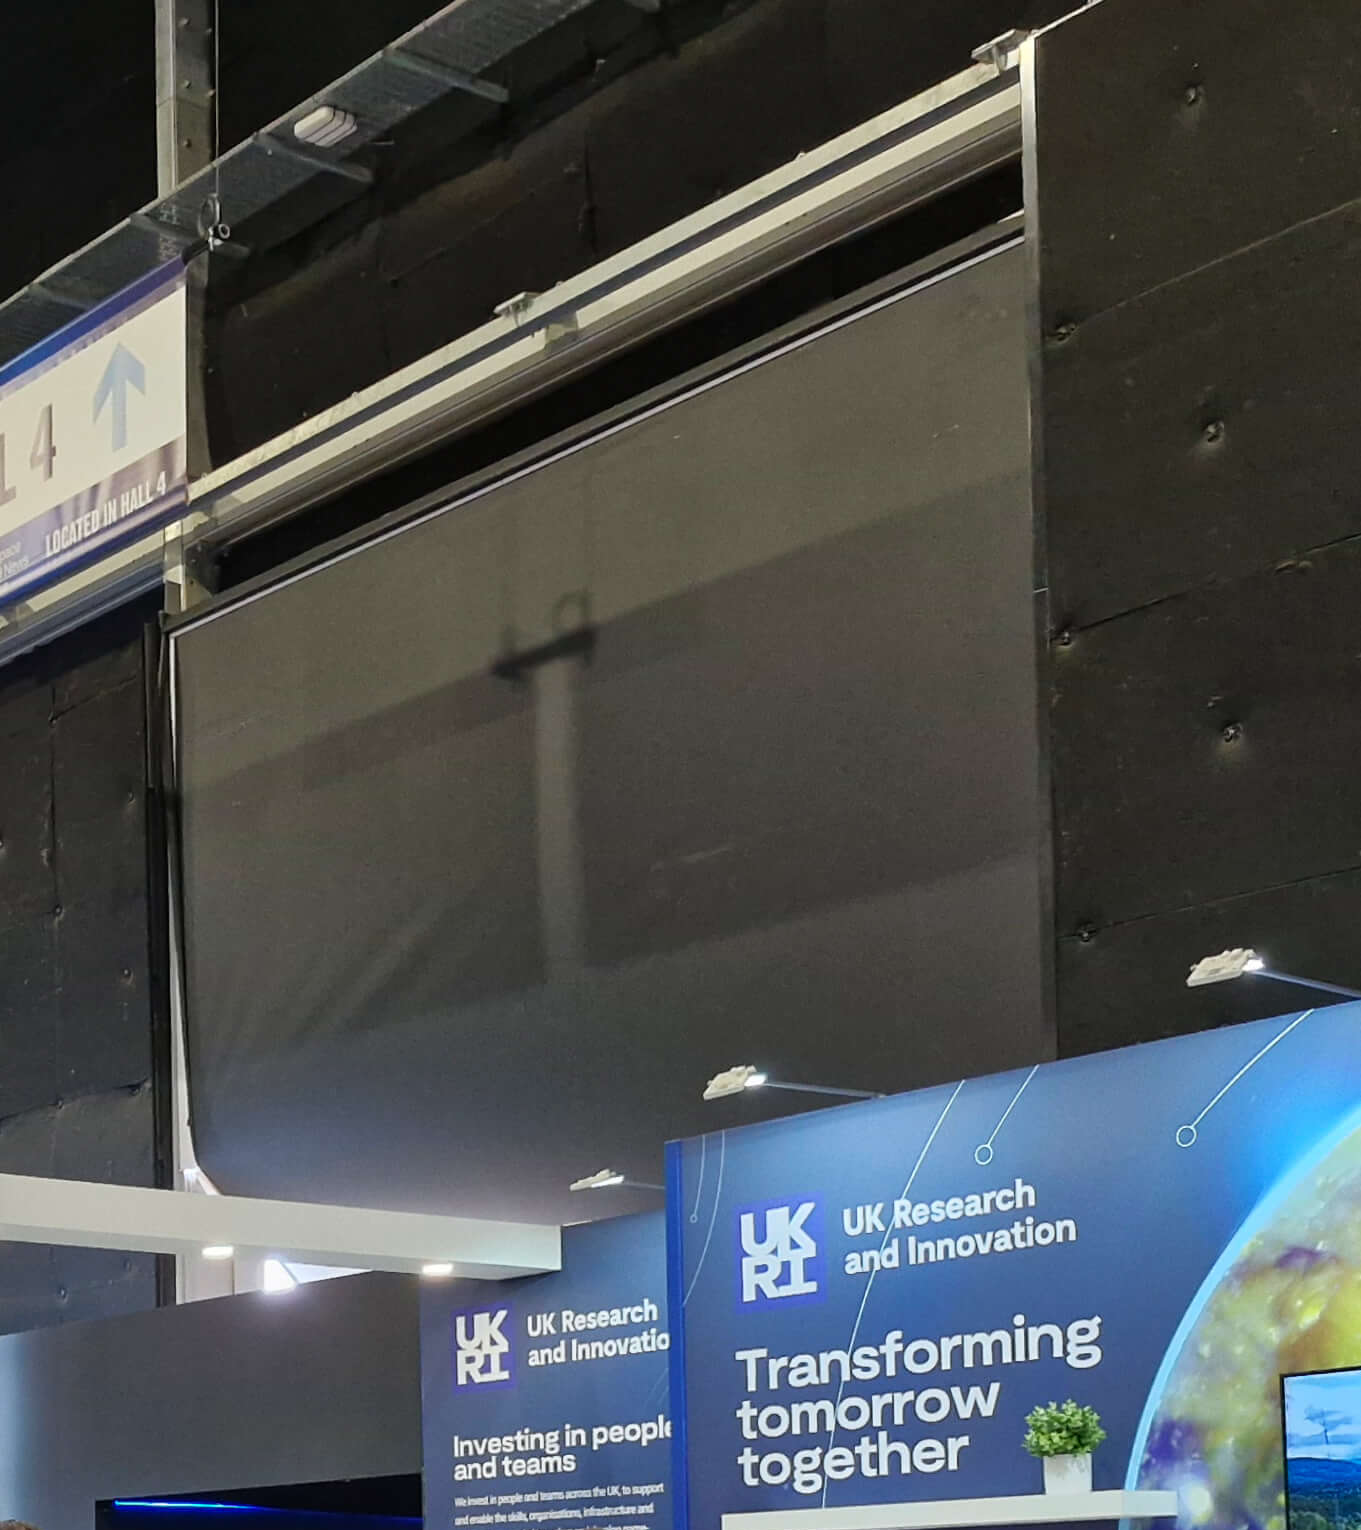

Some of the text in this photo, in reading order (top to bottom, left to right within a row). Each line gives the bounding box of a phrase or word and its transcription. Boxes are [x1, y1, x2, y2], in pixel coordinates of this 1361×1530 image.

[30, 403, 57, 482] 4
[45, 471, 166, 558] LOCATED IN HALL 4
[843, 1179, 1036, 1237] UK Research
[844, 1216, 1077, 1275] and Innovation
[527, 1298, 658, 1337] UK Research
[528, 1340, 566, 1367] and
[735, 1313, 1103, 1392] Transforming
[736, 1382, 1001, 1440] tomorrow
[453, 1427, 560, 1458] Investing
[564, 1424, 587, 1447] in
[453, 1453, 577, 1481] and teams
[737, 1430, 970, 1495] together
[592, 1485, 606, 1497] the
[606, 1485, 621, 1497] UK,
[621, 1485, 631, 1495] to
[632, 1482, 664, 1496] support
